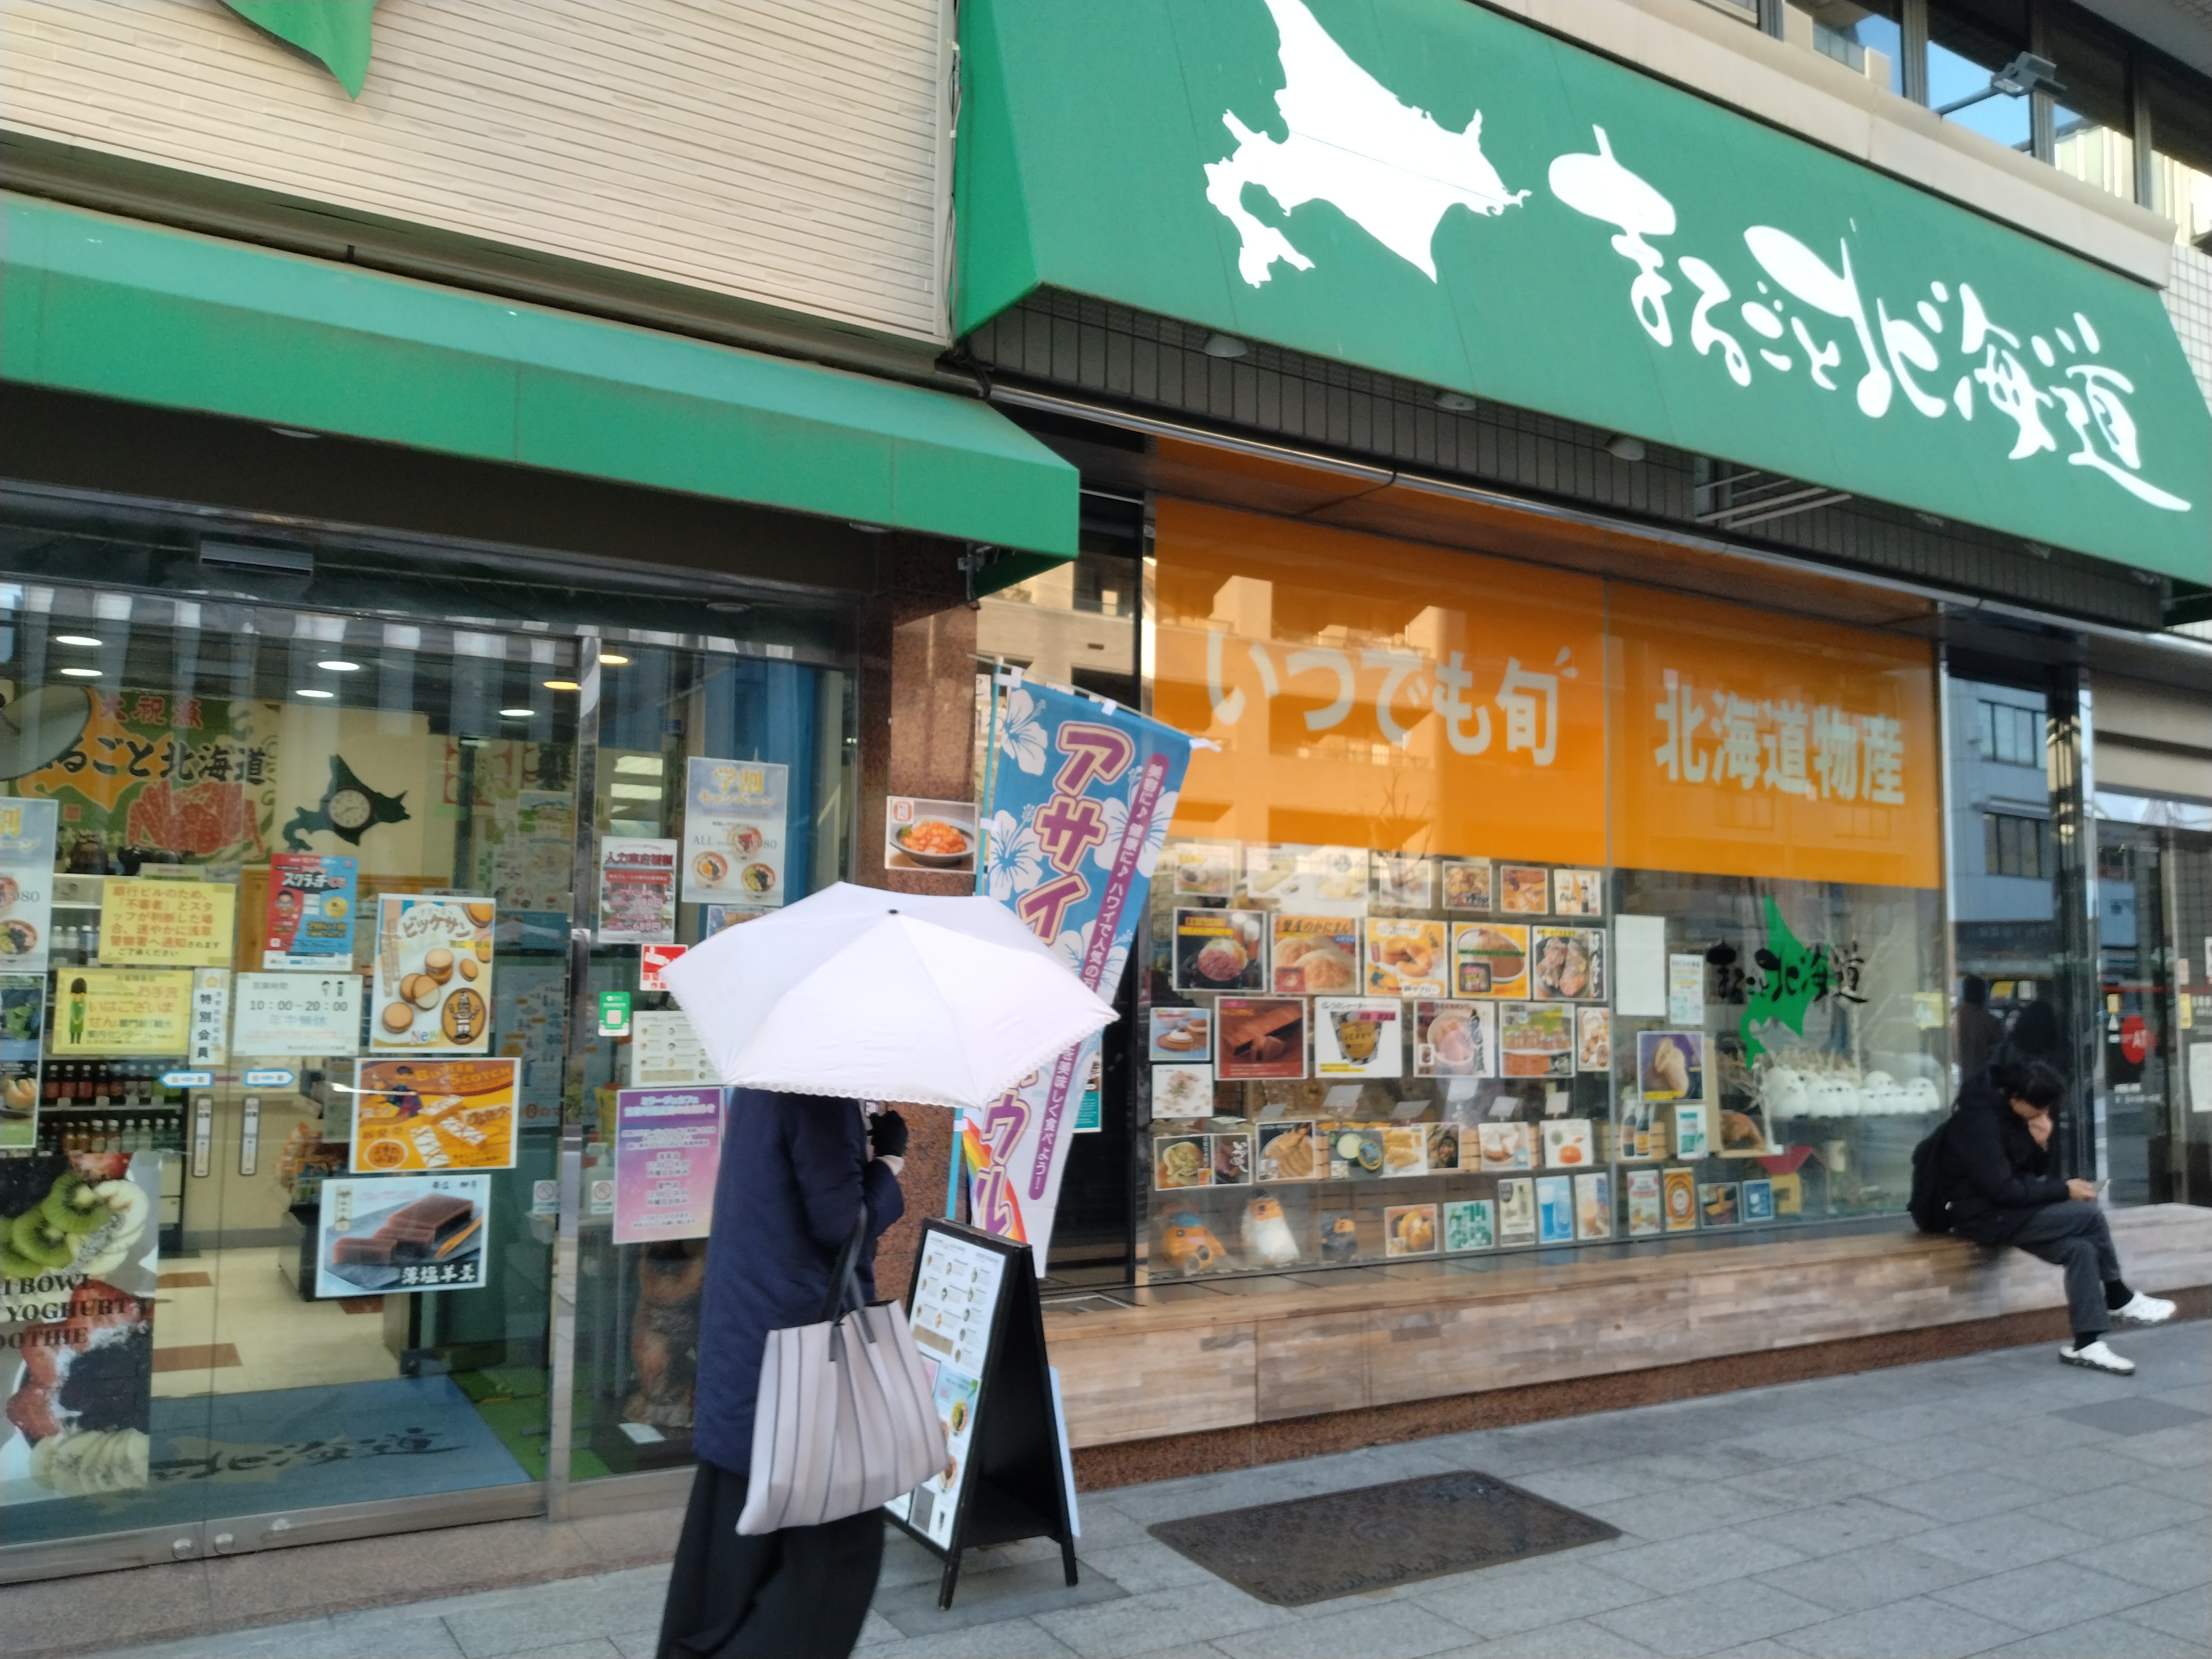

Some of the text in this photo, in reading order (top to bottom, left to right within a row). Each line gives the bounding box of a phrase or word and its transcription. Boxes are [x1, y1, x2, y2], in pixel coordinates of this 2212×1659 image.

[1548, 124, 2192, 512] まるごと北海道
[1207, 629, 1558, 766] いつでも旬
[1655, 676, 1905, 805] 北海道物産
[39, 736, 266, 785] るごと北海道
[693, 835, 713, 845] ALL
[19, 1273, 96, 1295] BOWL
